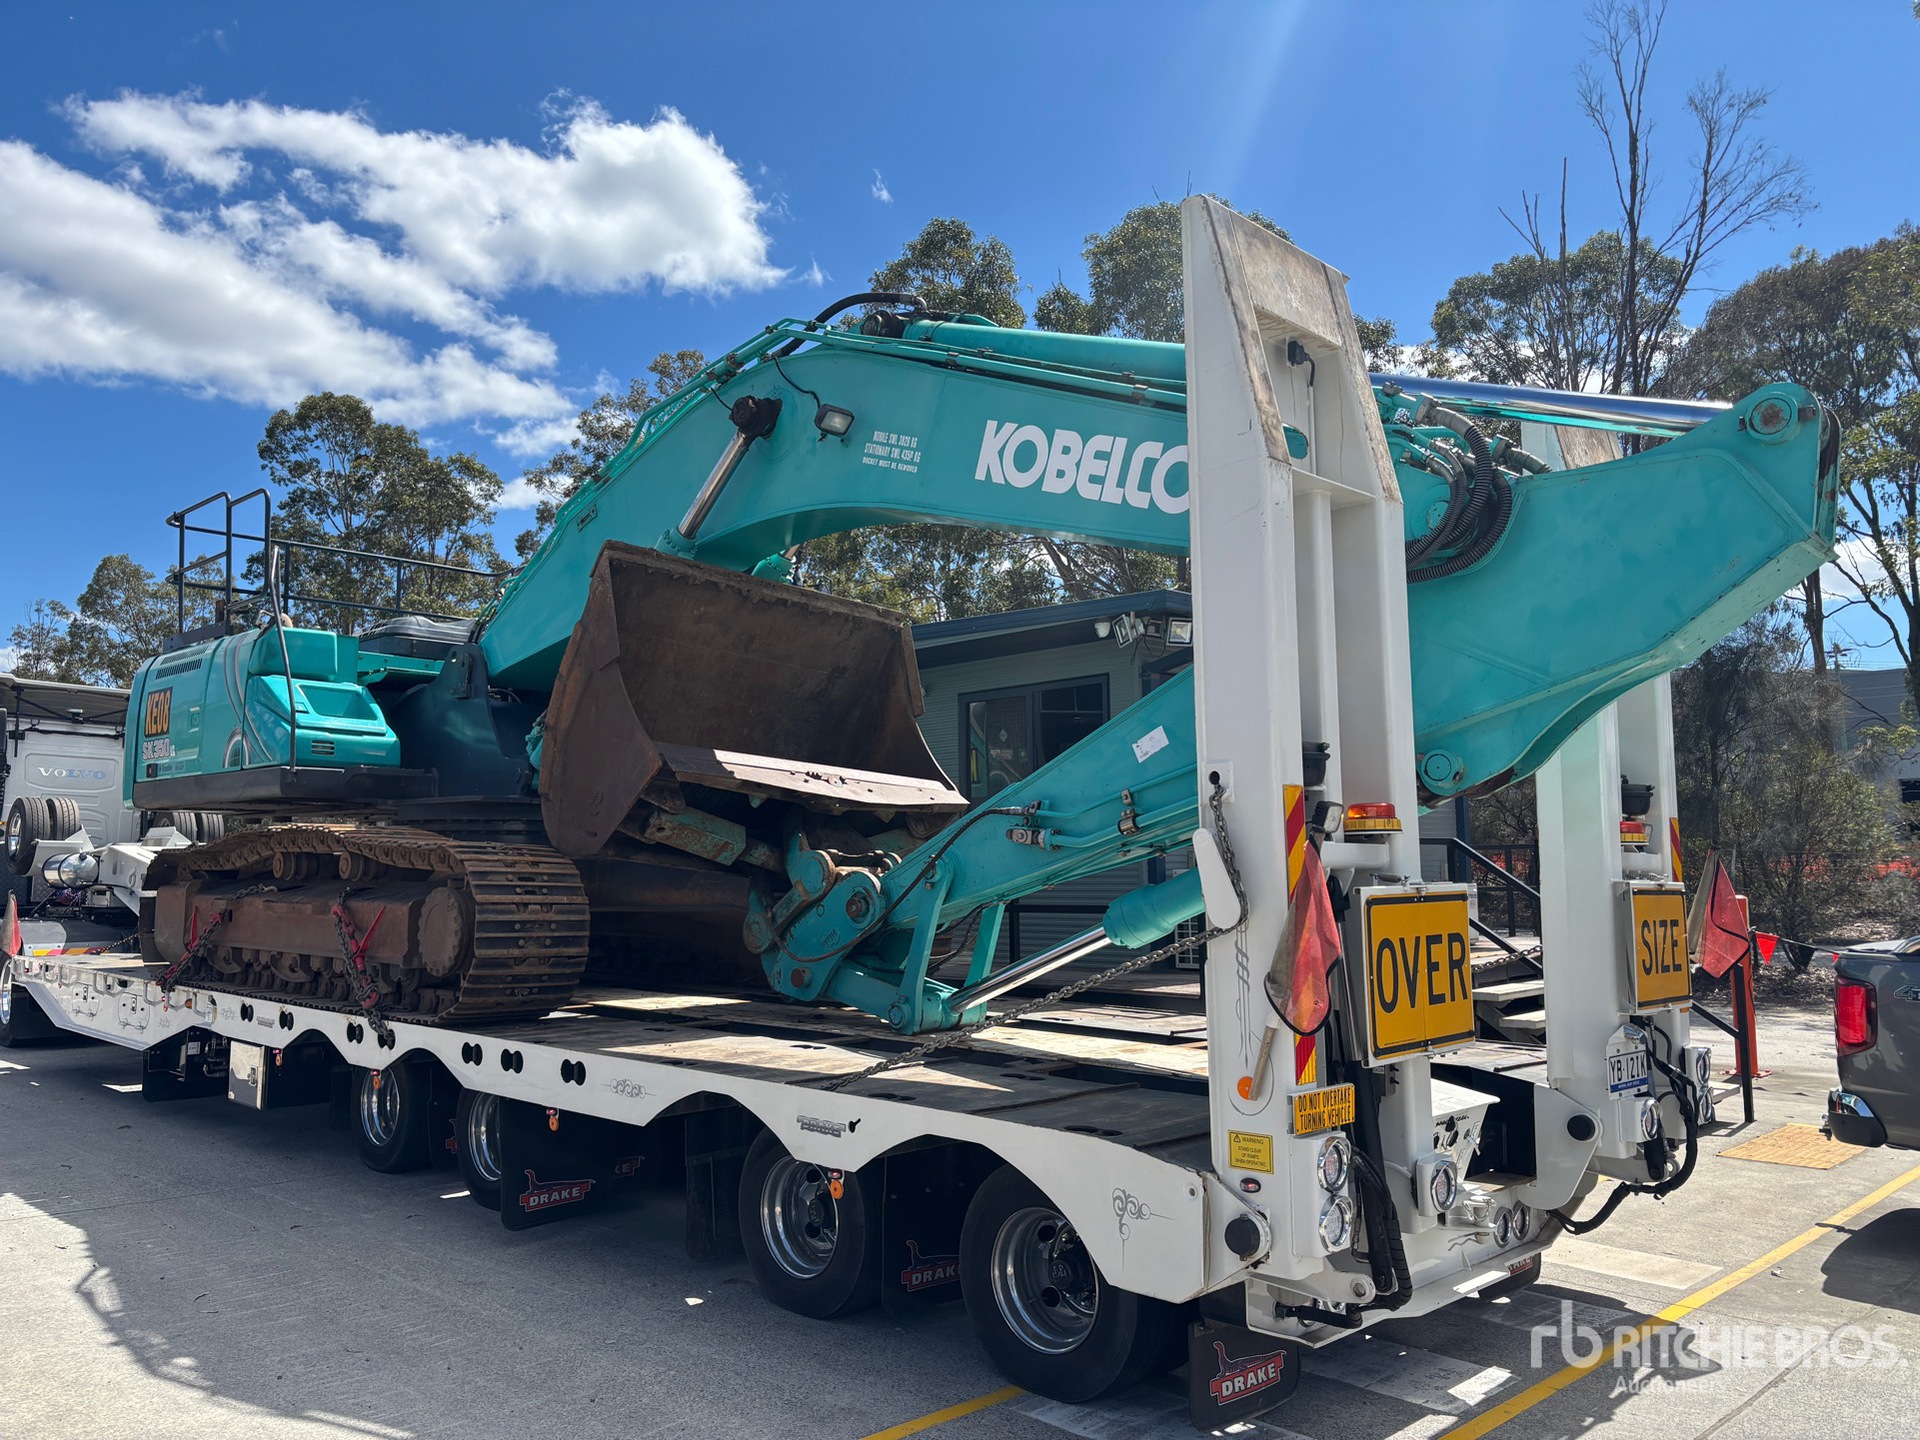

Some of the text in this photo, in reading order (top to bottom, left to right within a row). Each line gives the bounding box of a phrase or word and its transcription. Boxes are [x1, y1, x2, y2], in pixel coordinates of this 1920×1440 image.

[975, 420, 1189, 514] KOBELCO
[145, 690, 171, 735] KE08
[38, 767, 106, 780] VOLVO
[1641, 919, 1682, 976] SIZE
[1376, 932, 1468, 1013] OVER
[1299, 1087, 1351, 1112] DO NOT OVERTAKE
[1300, 1105, 1351, 1130] TURNING VEHICLE
[1242, 1136, 1264, 1145] WARNING
[529, 1187, 580, 1206] DRAKE
[912, 1264, 957, 1285] DRAK
[1221, 1363, 1276, 1397] DRAKE
